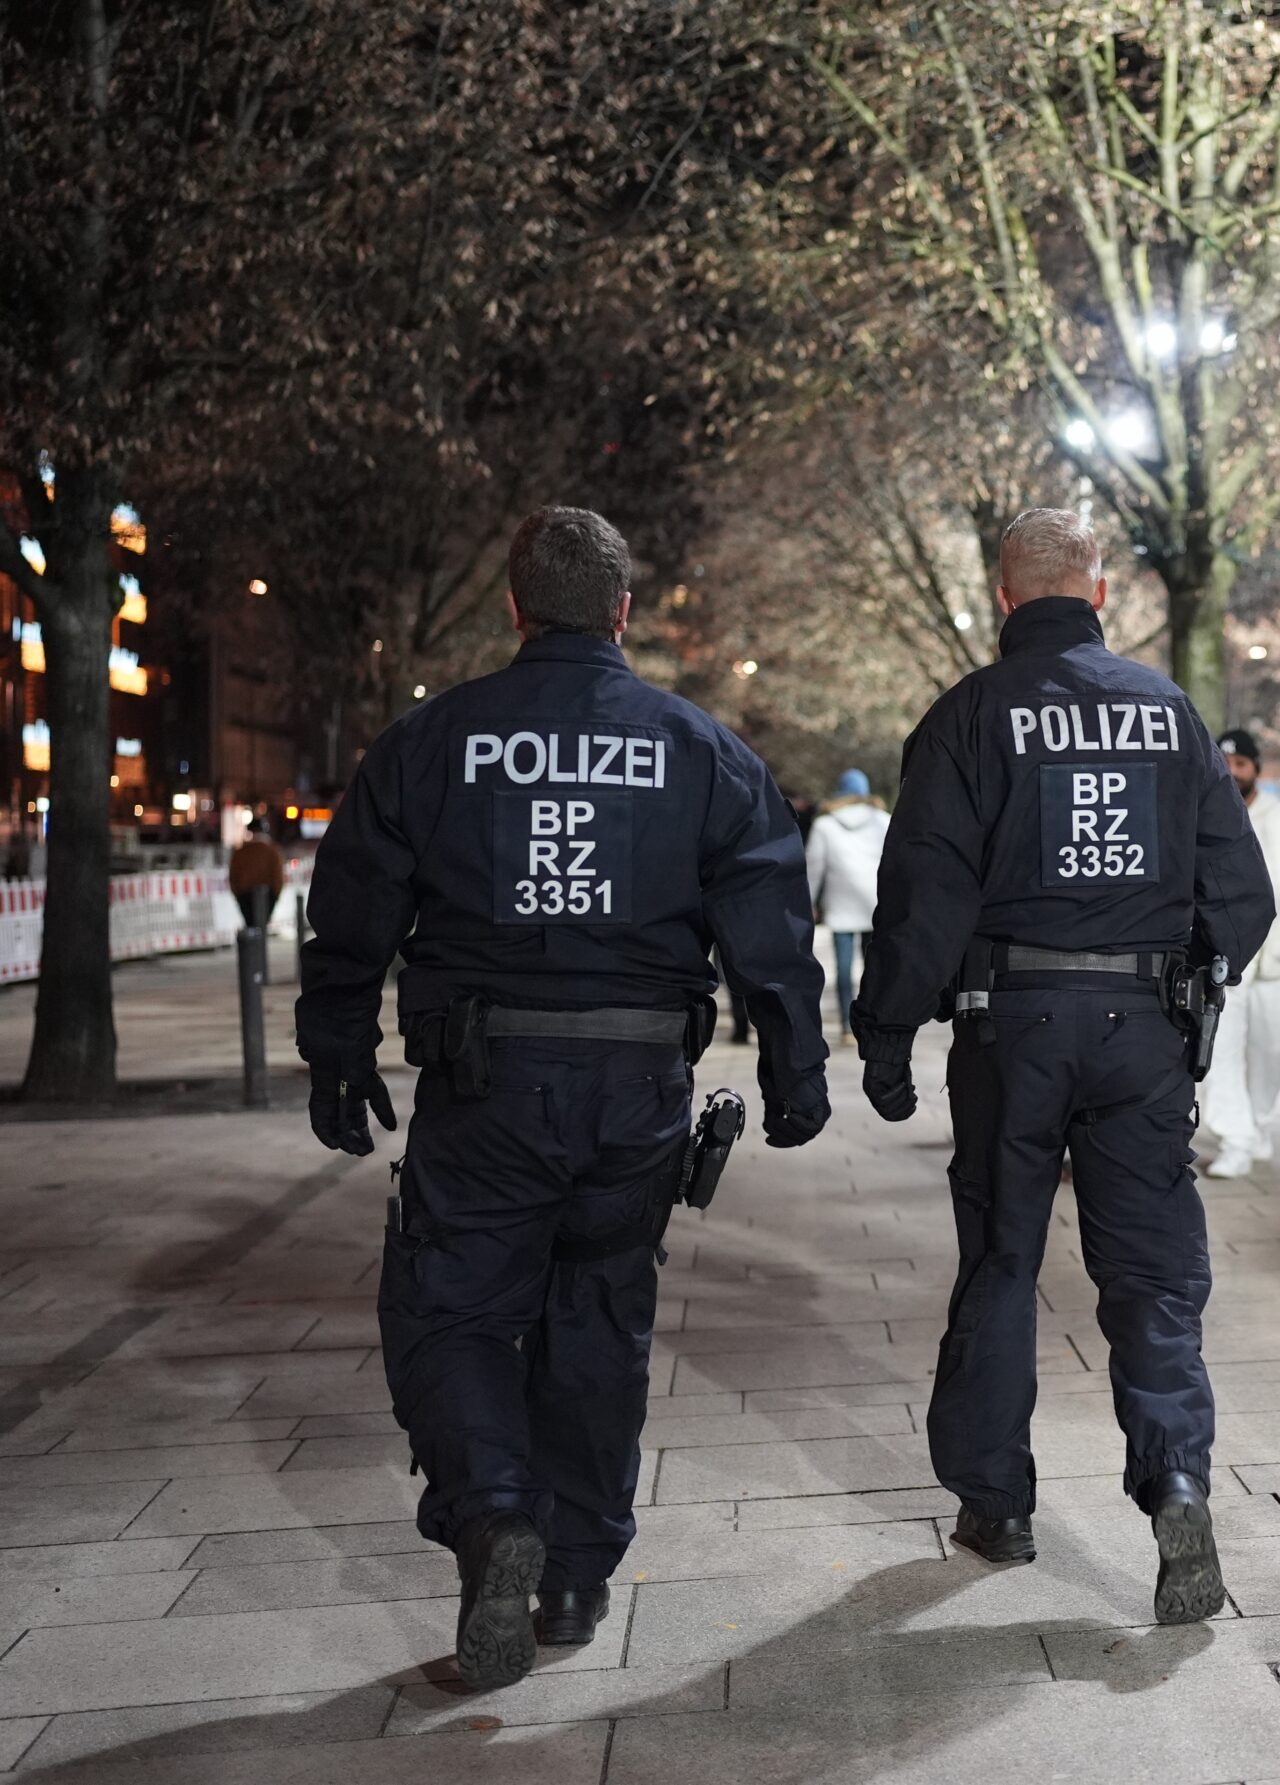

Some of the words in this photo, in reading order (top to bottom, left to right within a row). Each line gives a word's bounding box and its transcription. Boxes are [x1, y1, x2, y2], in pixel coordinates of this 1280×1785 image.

[1010, 703, 1179, 755] POLIZEI
[464, 731, 665, 788] POLIZEI
[1073, 772, 1127, 805] BP
[531, 800, 595, 836] BP
[1072, 808, 1129, 842] RZ
[529, 840, 596, 876] RZ
[1058, 844, 1145, 878] 3352
[514, 879, 612, 915] 3351
